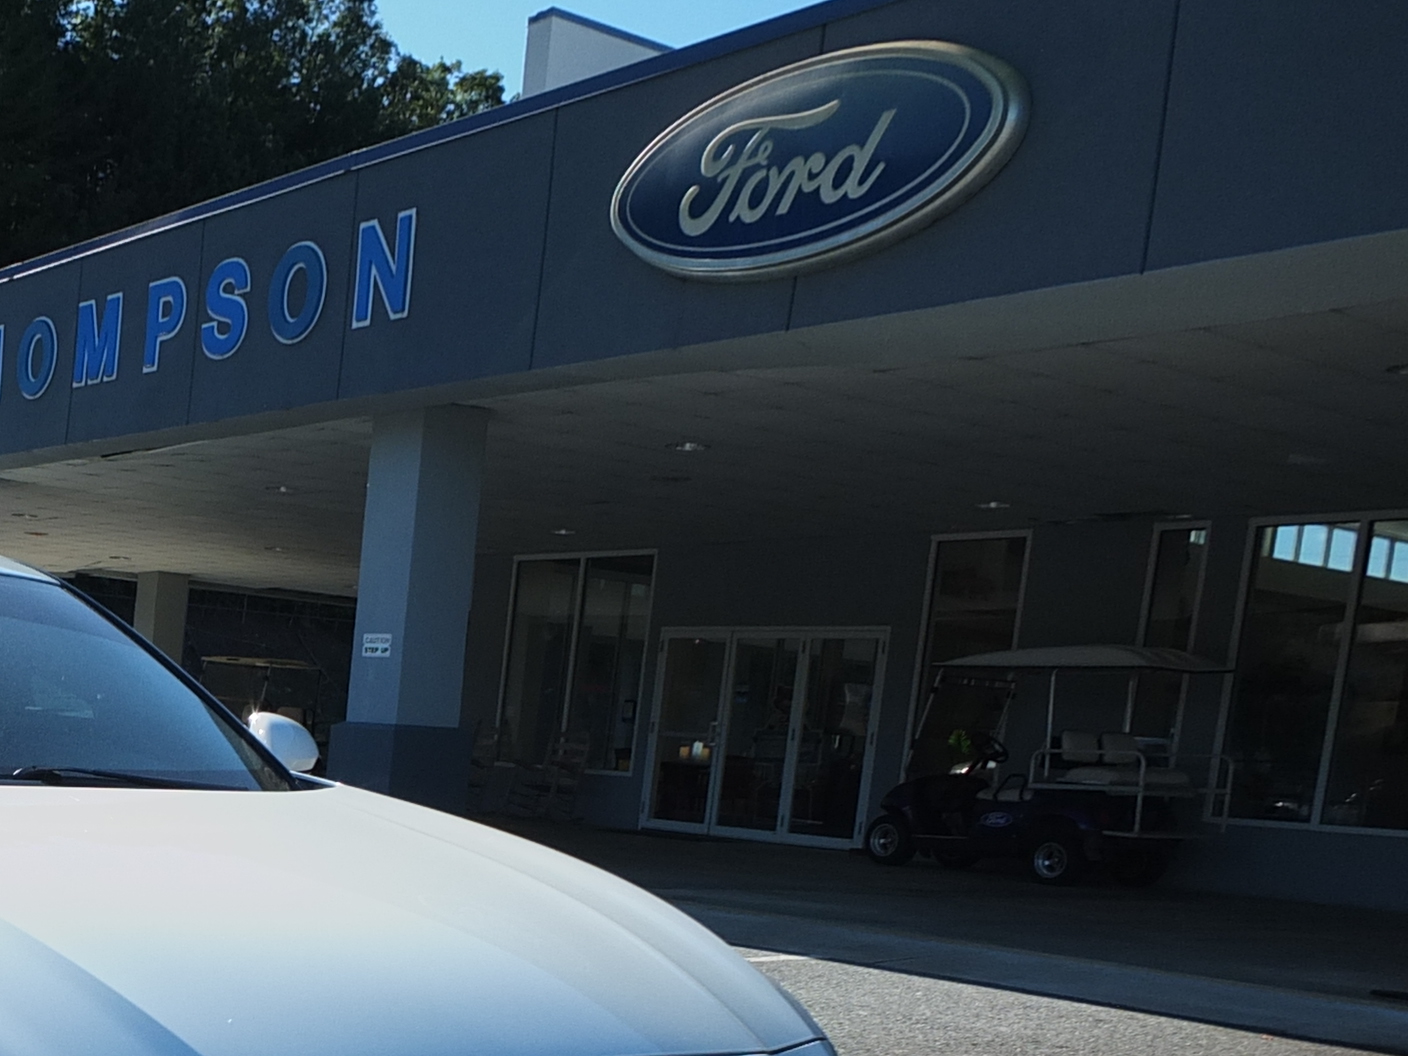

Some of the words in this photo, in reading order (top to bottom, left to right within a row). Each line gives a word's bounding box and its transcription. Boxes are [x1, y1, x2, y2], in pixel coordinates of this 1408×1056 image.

[678, 99, 897, 236] Ford
[365, 636, 390, 645] CAUTION
[364, 646, 379, 654] STEP
[380, 646, 389, 654] UP
